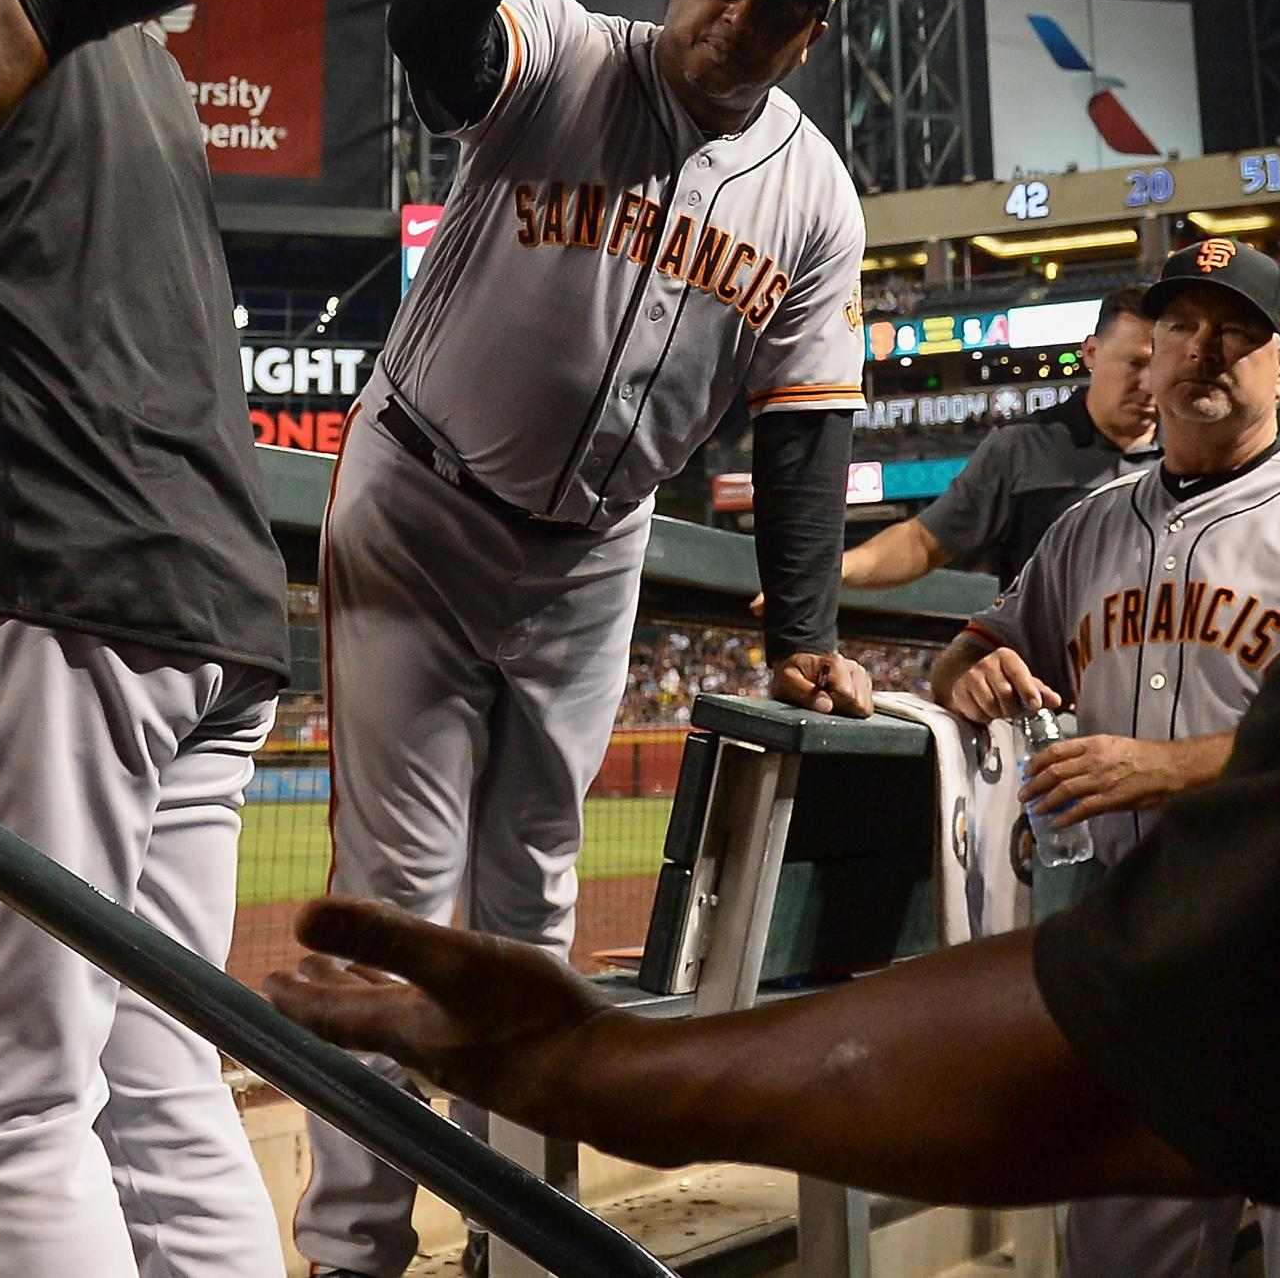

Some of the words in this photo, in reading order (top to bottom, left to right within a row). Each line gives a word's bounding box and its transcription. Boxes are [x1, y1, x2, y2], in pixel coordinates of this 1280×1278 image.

[1004, 181, 1050, 220] 42
[1124, 168, 1175, 208] 20
[515, 178, 607, 249] SAN
